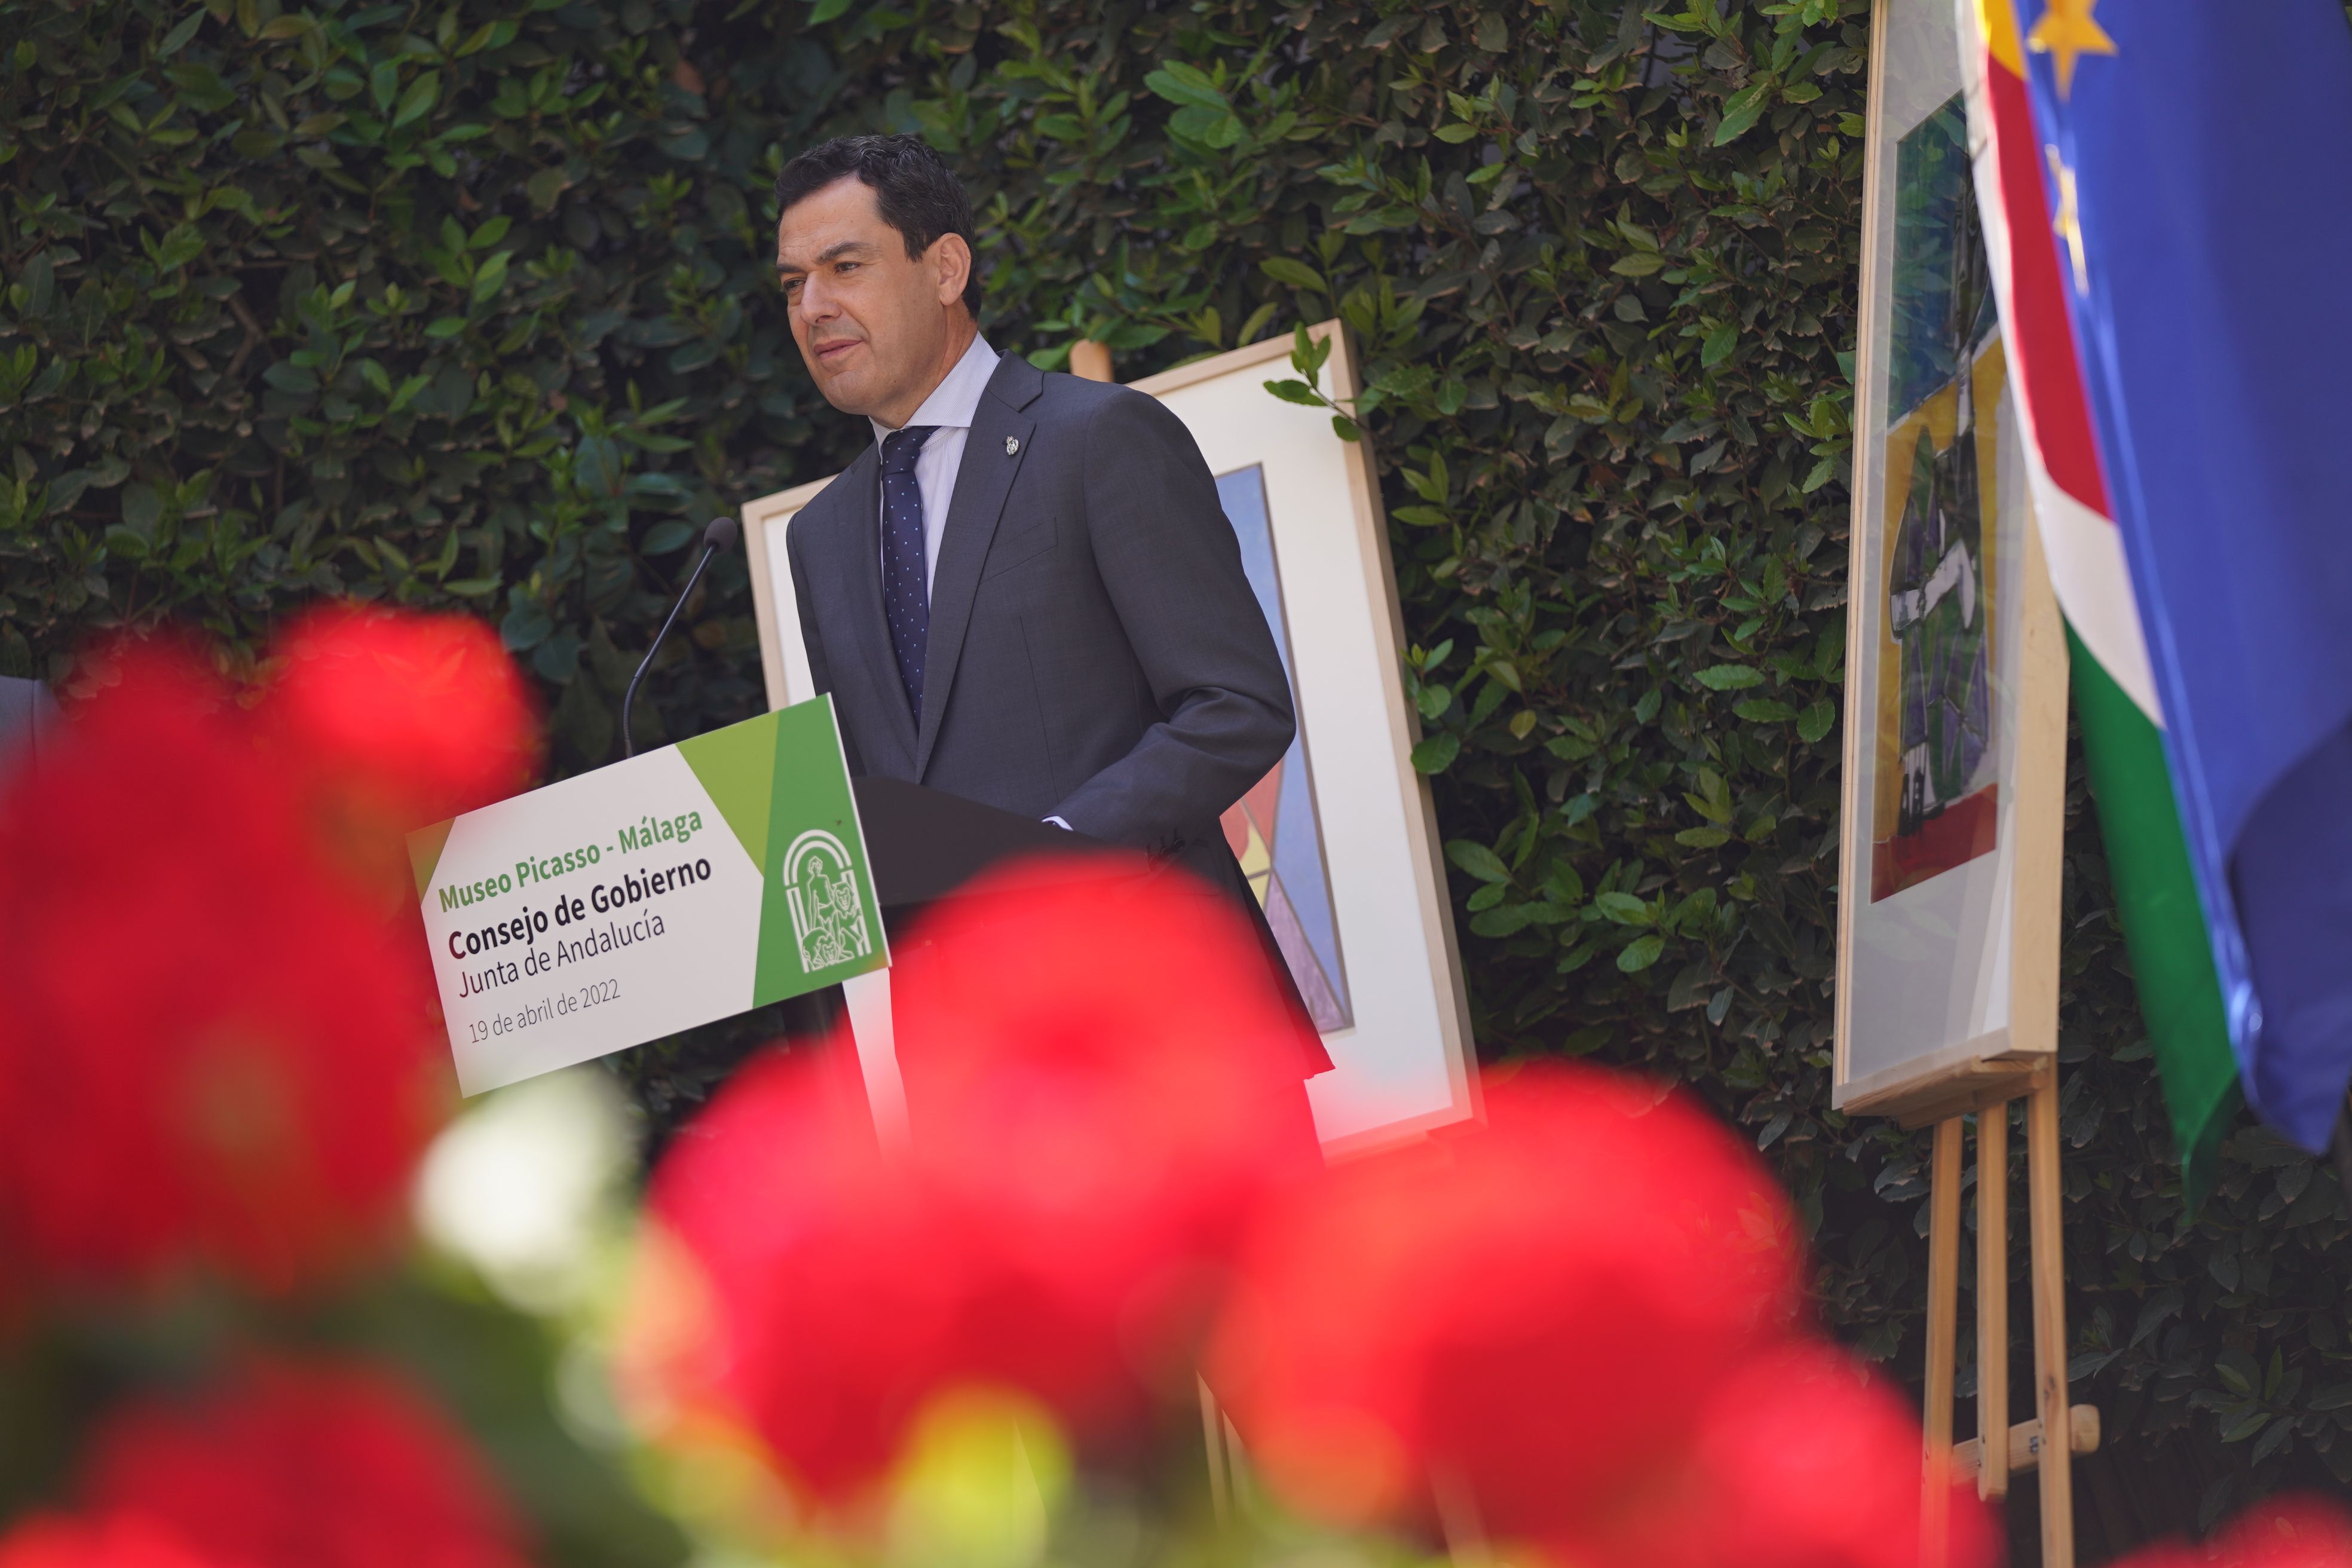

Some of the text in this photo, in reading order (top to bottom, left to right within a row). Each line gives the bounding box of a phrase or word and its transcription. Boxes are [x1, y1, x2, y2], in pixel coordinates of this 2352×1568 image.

[439, 874, 512, 912] Museo
[515, 844, 600, 887] Picasso
[618, 811, 703, 854] Málaga
[449, 858, 711, 959] Consejo de Gobierno
[460, 908, 664, 998] Junta de Andalucía
[470, 979, 621, 1043] 19 de abril de 2022
